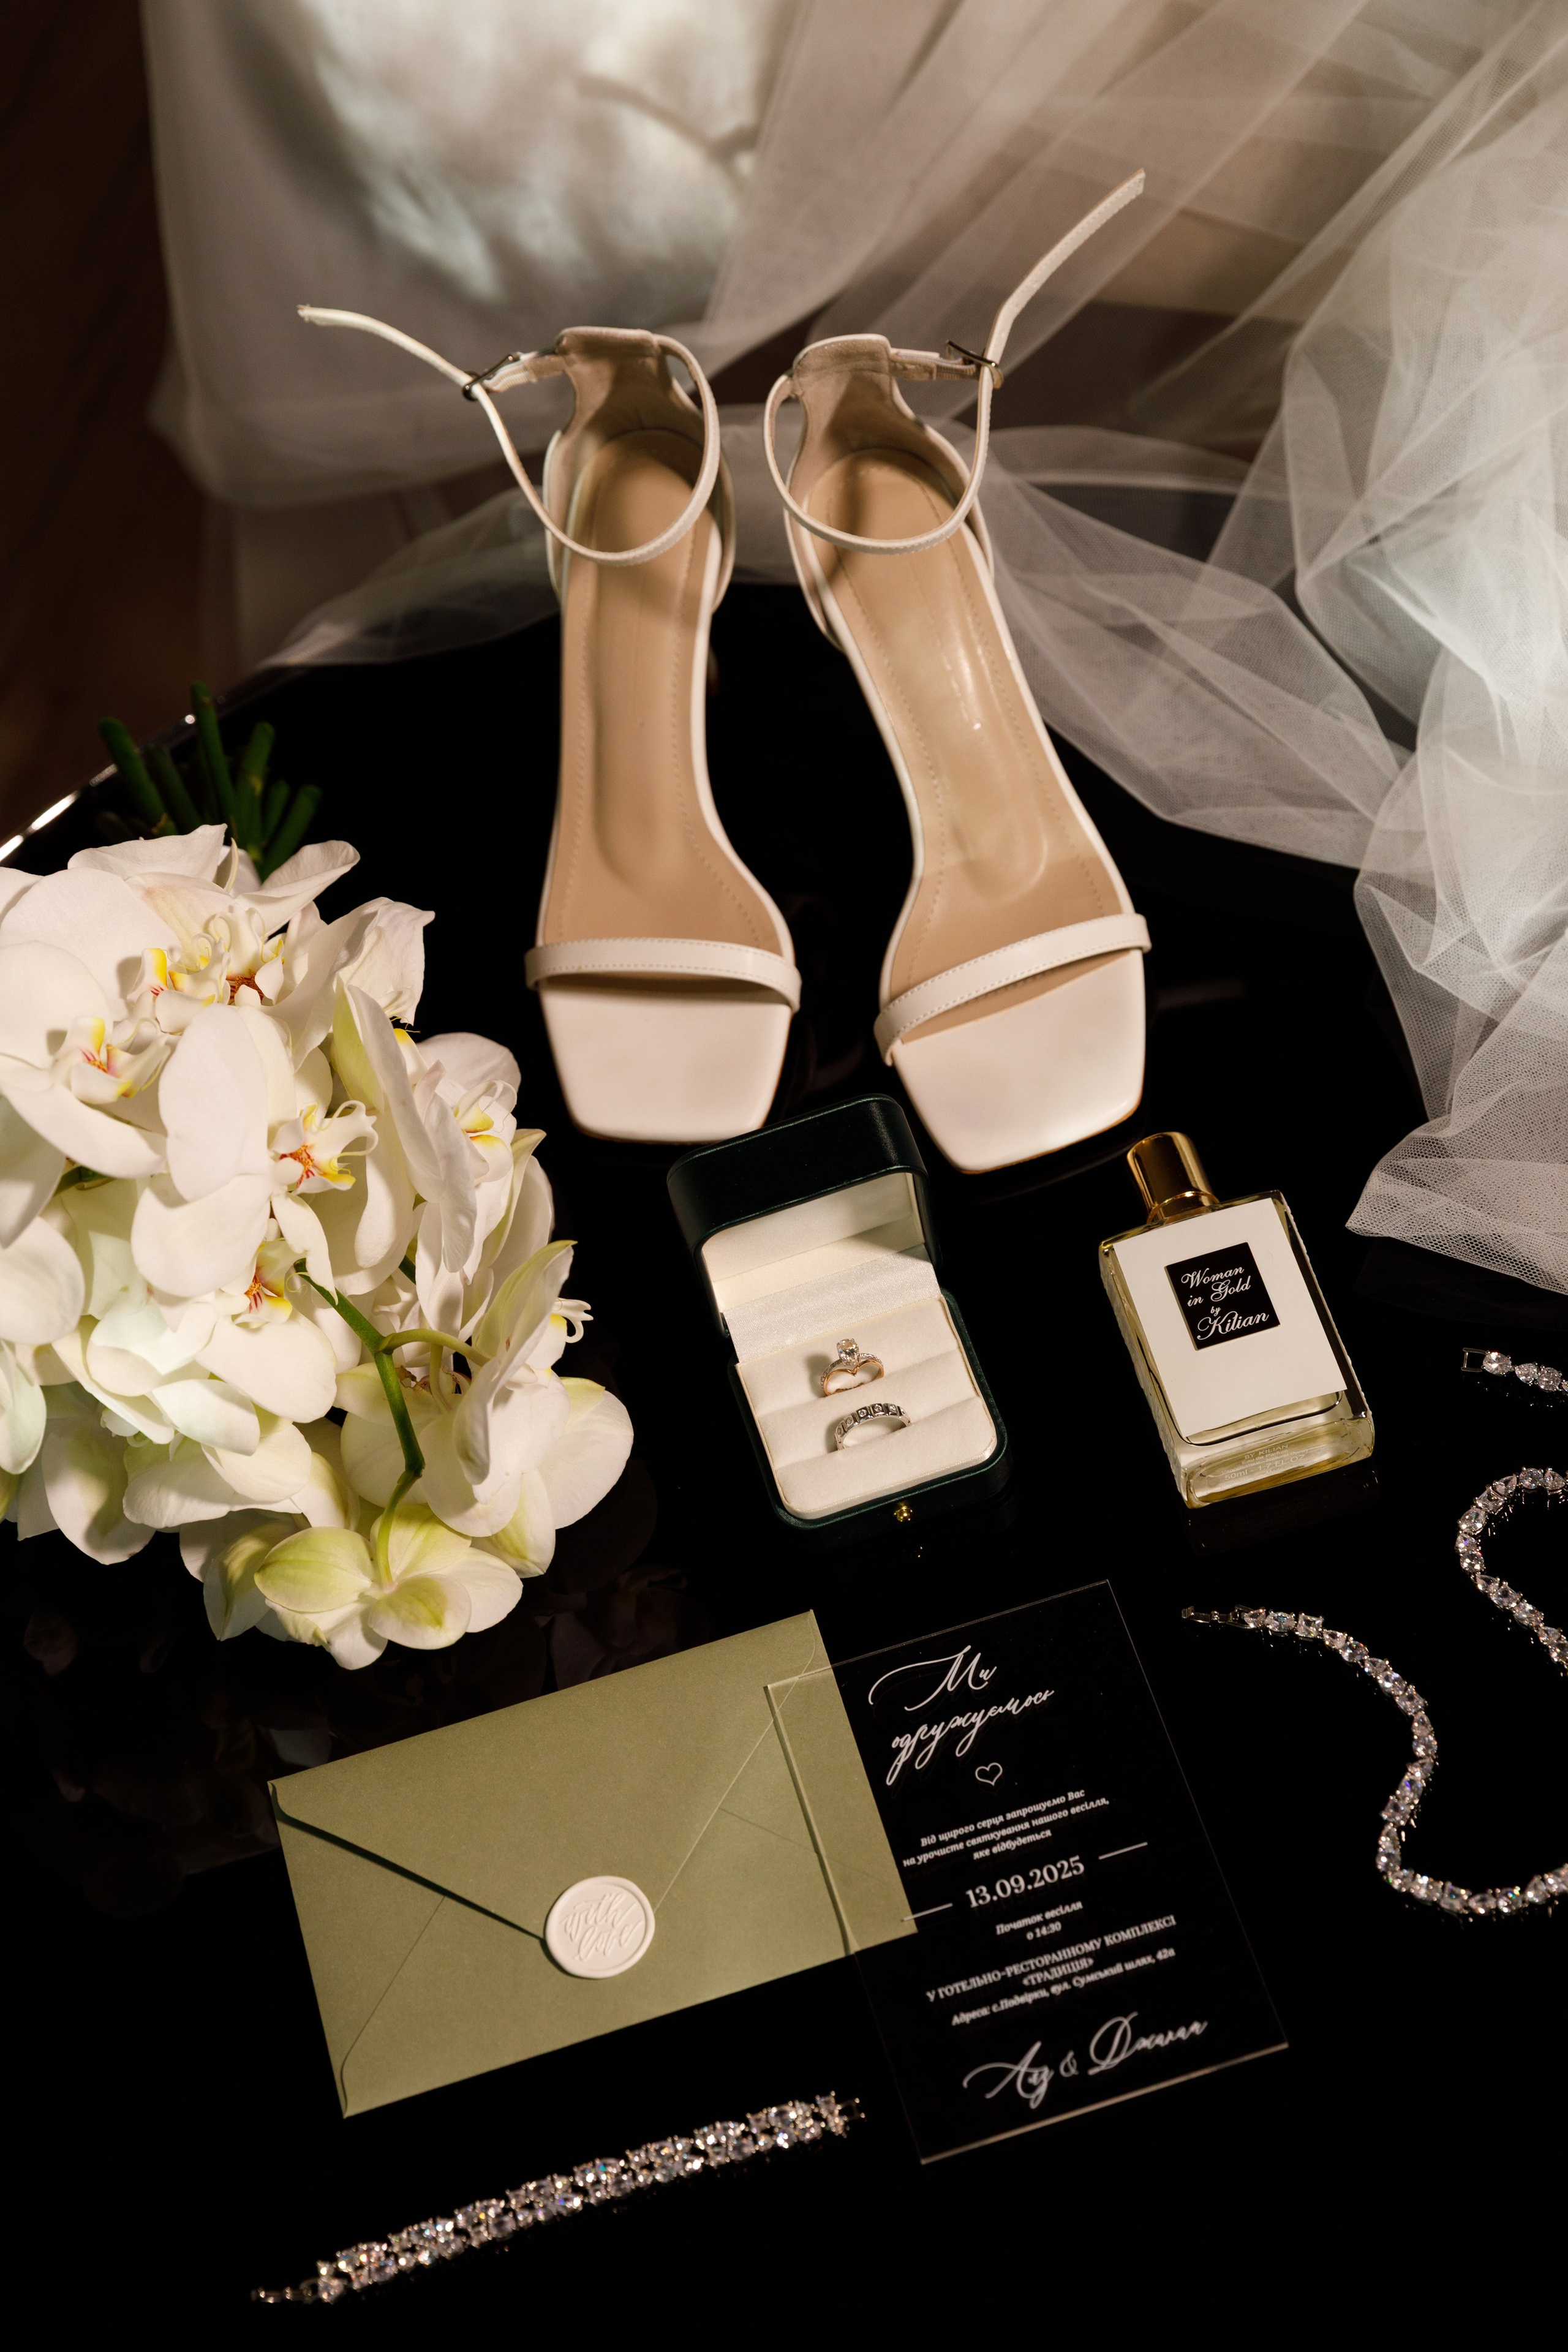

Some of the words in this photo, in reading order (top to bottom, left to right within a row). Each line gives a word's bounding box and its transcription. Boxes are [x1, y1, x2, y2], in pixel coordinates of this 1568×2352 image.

[1181, 1267, 1245, 1289] Woman
[1187, 1295, 1204, 1306] in
[1210, 1275, 1251, 1302] Gold
[1197, 1311, 1270, 1340] Kilian
[1210, 1306, 1221, 1316] by
[1259, 1444, 1288, 1455] KILIAN
[1266, 1449, 1288, 1458] Parfum
[1225, 1469, 1248, 1480] 50ml
[902, 1856, 916, 1868] на
[916, 1842, 965, 1865] урочисте
[965, 1820, 1030, 1848] святкування
[1031, 1809, 1069, 1827] нашого
[1070, 1796, 1110, 1815] весілля,
[920, 1833, 937, 1847] Від
[938, 1823, 975, 1842] щирого
[976, 1814, 1005, 1830] серця
[1005, 1795, 1066, 1821] запрошуємо
[1067, 1789, 1085, 1801] Вас
[973, 1847, 990, 1861] яке
[992, 1828, 1052, 1854] відбудеться
[965, 1855, 1085, 1909] 13.09.2025
[995, 1913, 1044, 1936] Початок
[1044, 1901, 1084, 1920] весілля
[1035, 1921, 1062, 1939] 14:30
[937, 1937, 1102, 1999] ГОТЕЛЬНО-РЕСТОРАННОМУ
[1103, 1914, 1177, 1947] КОМПЛЕКСІ
[1059, 2049, 1079, 2078] &
